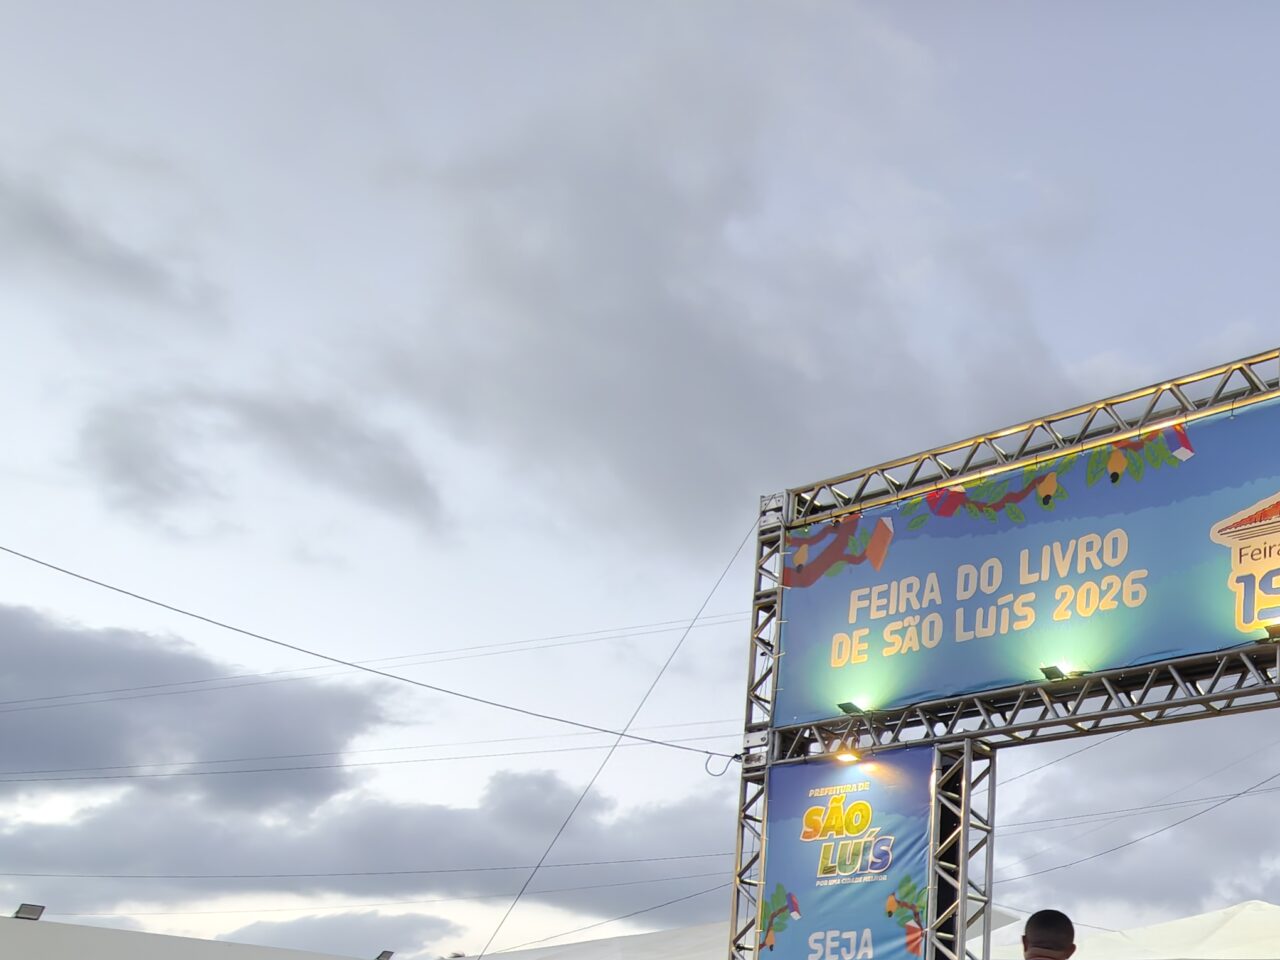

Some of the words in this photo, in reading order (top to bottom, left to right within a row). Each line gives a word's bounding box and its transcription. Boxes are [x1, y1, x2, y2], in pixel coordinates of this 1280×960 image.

[848, 572, 942, 624] FEIRA
[955, 557, 1003, 601] DO
[1019, 528, 1129, 585] LIVRO
[830, 628, 869, 668] DE
[882, 612, 943, 656] SÃO
[1053, 568, 1149, 621] 2026
[858, 781, 871, 793] DE
[800, 793, 873, 841] SÃO
[816, 827, 895, 878] LUÍS
